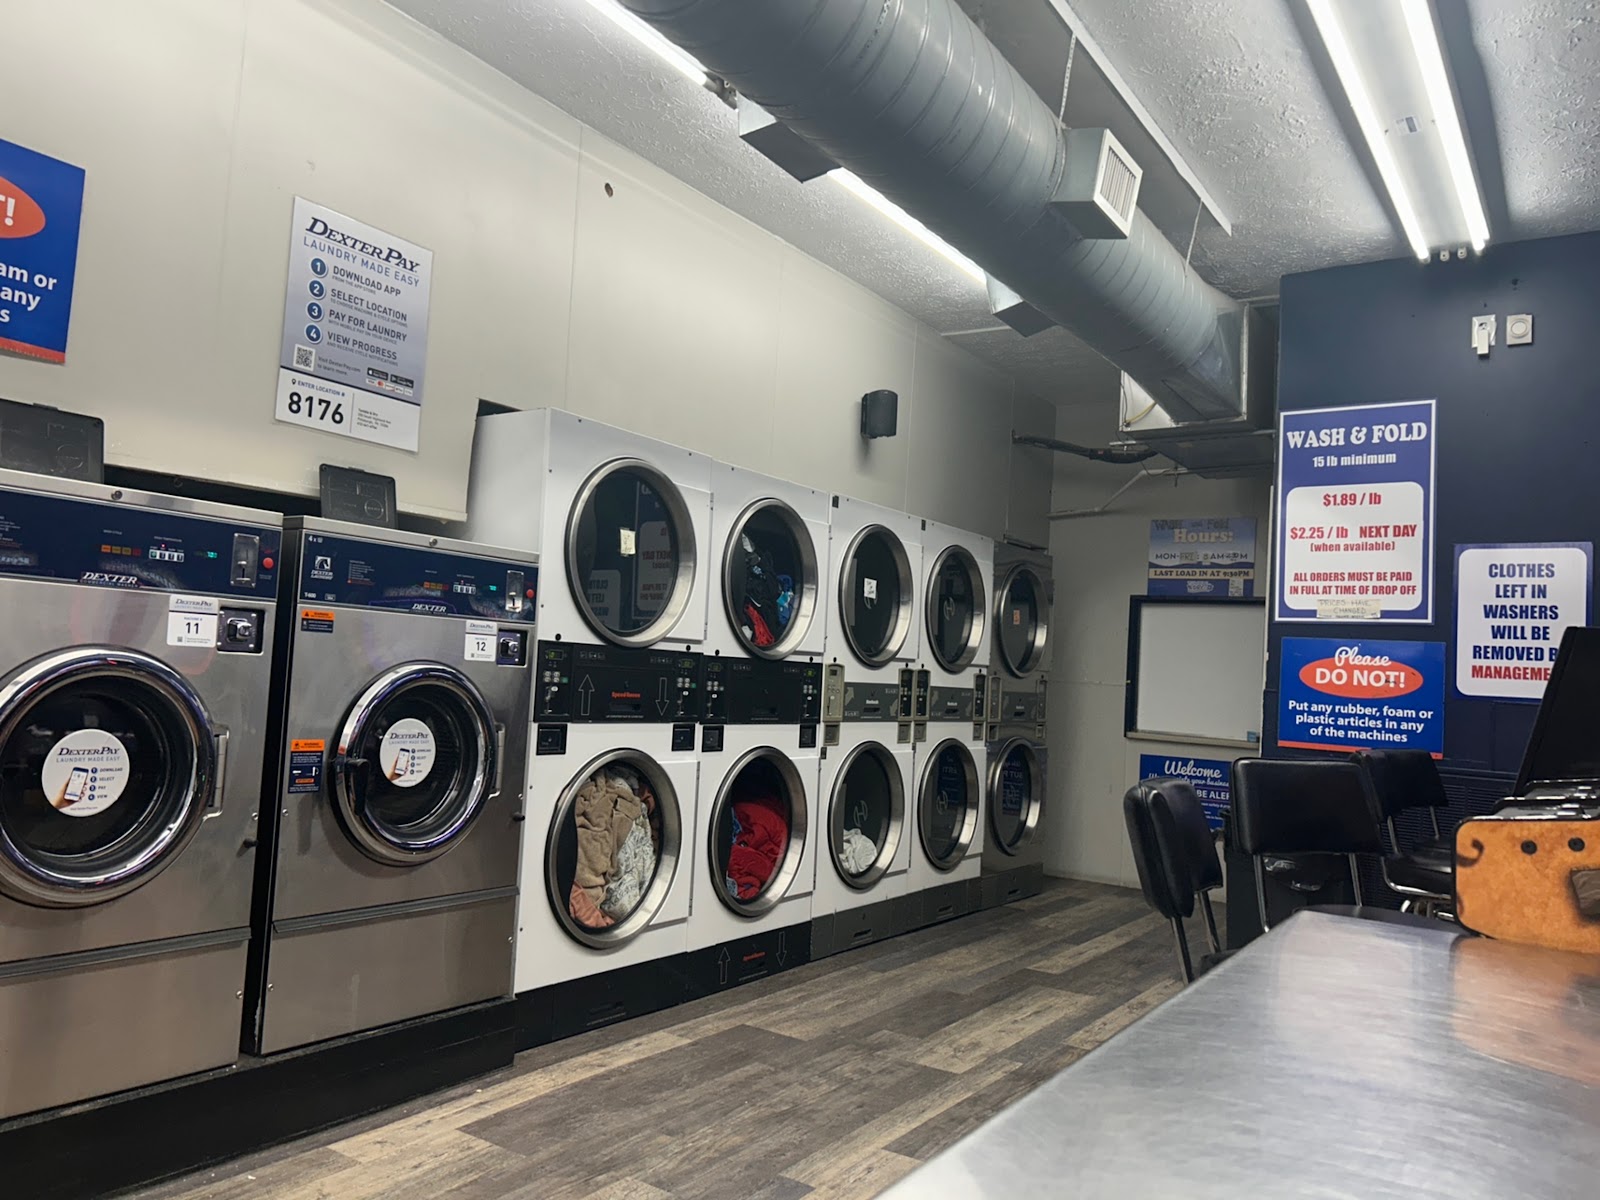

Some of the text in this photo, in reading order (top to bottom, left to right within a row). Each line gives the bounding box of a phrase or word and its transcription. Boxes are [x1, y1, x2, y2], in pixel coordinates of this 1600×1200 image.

[304, 236, 420, 287] LAUNDRY MADE EASY
[34, 273, 57, 290] or
[333, 266, 382, 290] DOWNLOAD
[384, 285, 401, 296] APP
[0, 287, 40, 311] any
[331, 288, 364, 306] SELECT
[366, 300, 408, 321] LOCATION
[329, 310, 346, 322] PAY
[348, 316, 366, 328] FOR
[367, 322, 408, 342] LAUNDRY
[328, 331, 350, 346] VIEW
[352, 340, 397, 360] PROGRESS
[298, 380, 315, 390] ENTER
[316, 384, 340, 396] LOCATION
[288, 392, 344, 424] 8176
[1286, 422, 1428, 448] WASH & FOLD
[1312, 453, 1396, 468] 15 lb minimum
[1322, 492, 1382, 507] $1.89 / lb
[1174, 528, 1234, 543] Hours:
[1290, 524, 1417, 540] $2.25 / lb NEXT DAY
[1310, 541, 1395, 552] (when available)
[82, 572, 138, 584] DEXTER
[1294, 572, 1412, 582] ALL ORDERS MUST BE PAID
[1488, 563, 1556, 578] CLOTHES
[1290, 586, 1416, 594] IN FULL AT TIME OF DROP OFF
[1495, 584, 1547, 598] LEFT IN
[412, 603, 446, 613] DEXTER
[1333, 606, 1366, 614] CHANGED
[1484, 604, 1559, 620] WASHERS
[186, 622, 200, 634] 11
[1491, 625, 1550, 640] WILL BE
[476, 641, 486, 652] 12
[1472, 645, 1544, 662] REMOVED
[1334, 646, 1392, 667] Please
[1315, 668, 1406, 688] DO NOT!
[1288, 700, 1434, 719] Put any rubber, foam or
[1296, 713, 1424, 734] plastic articles in any
[1310, 726, 1408, 742] of the machines
[1164, 759, 1222, 778] Welcome
[1196, 790, 1208, 798] BE
